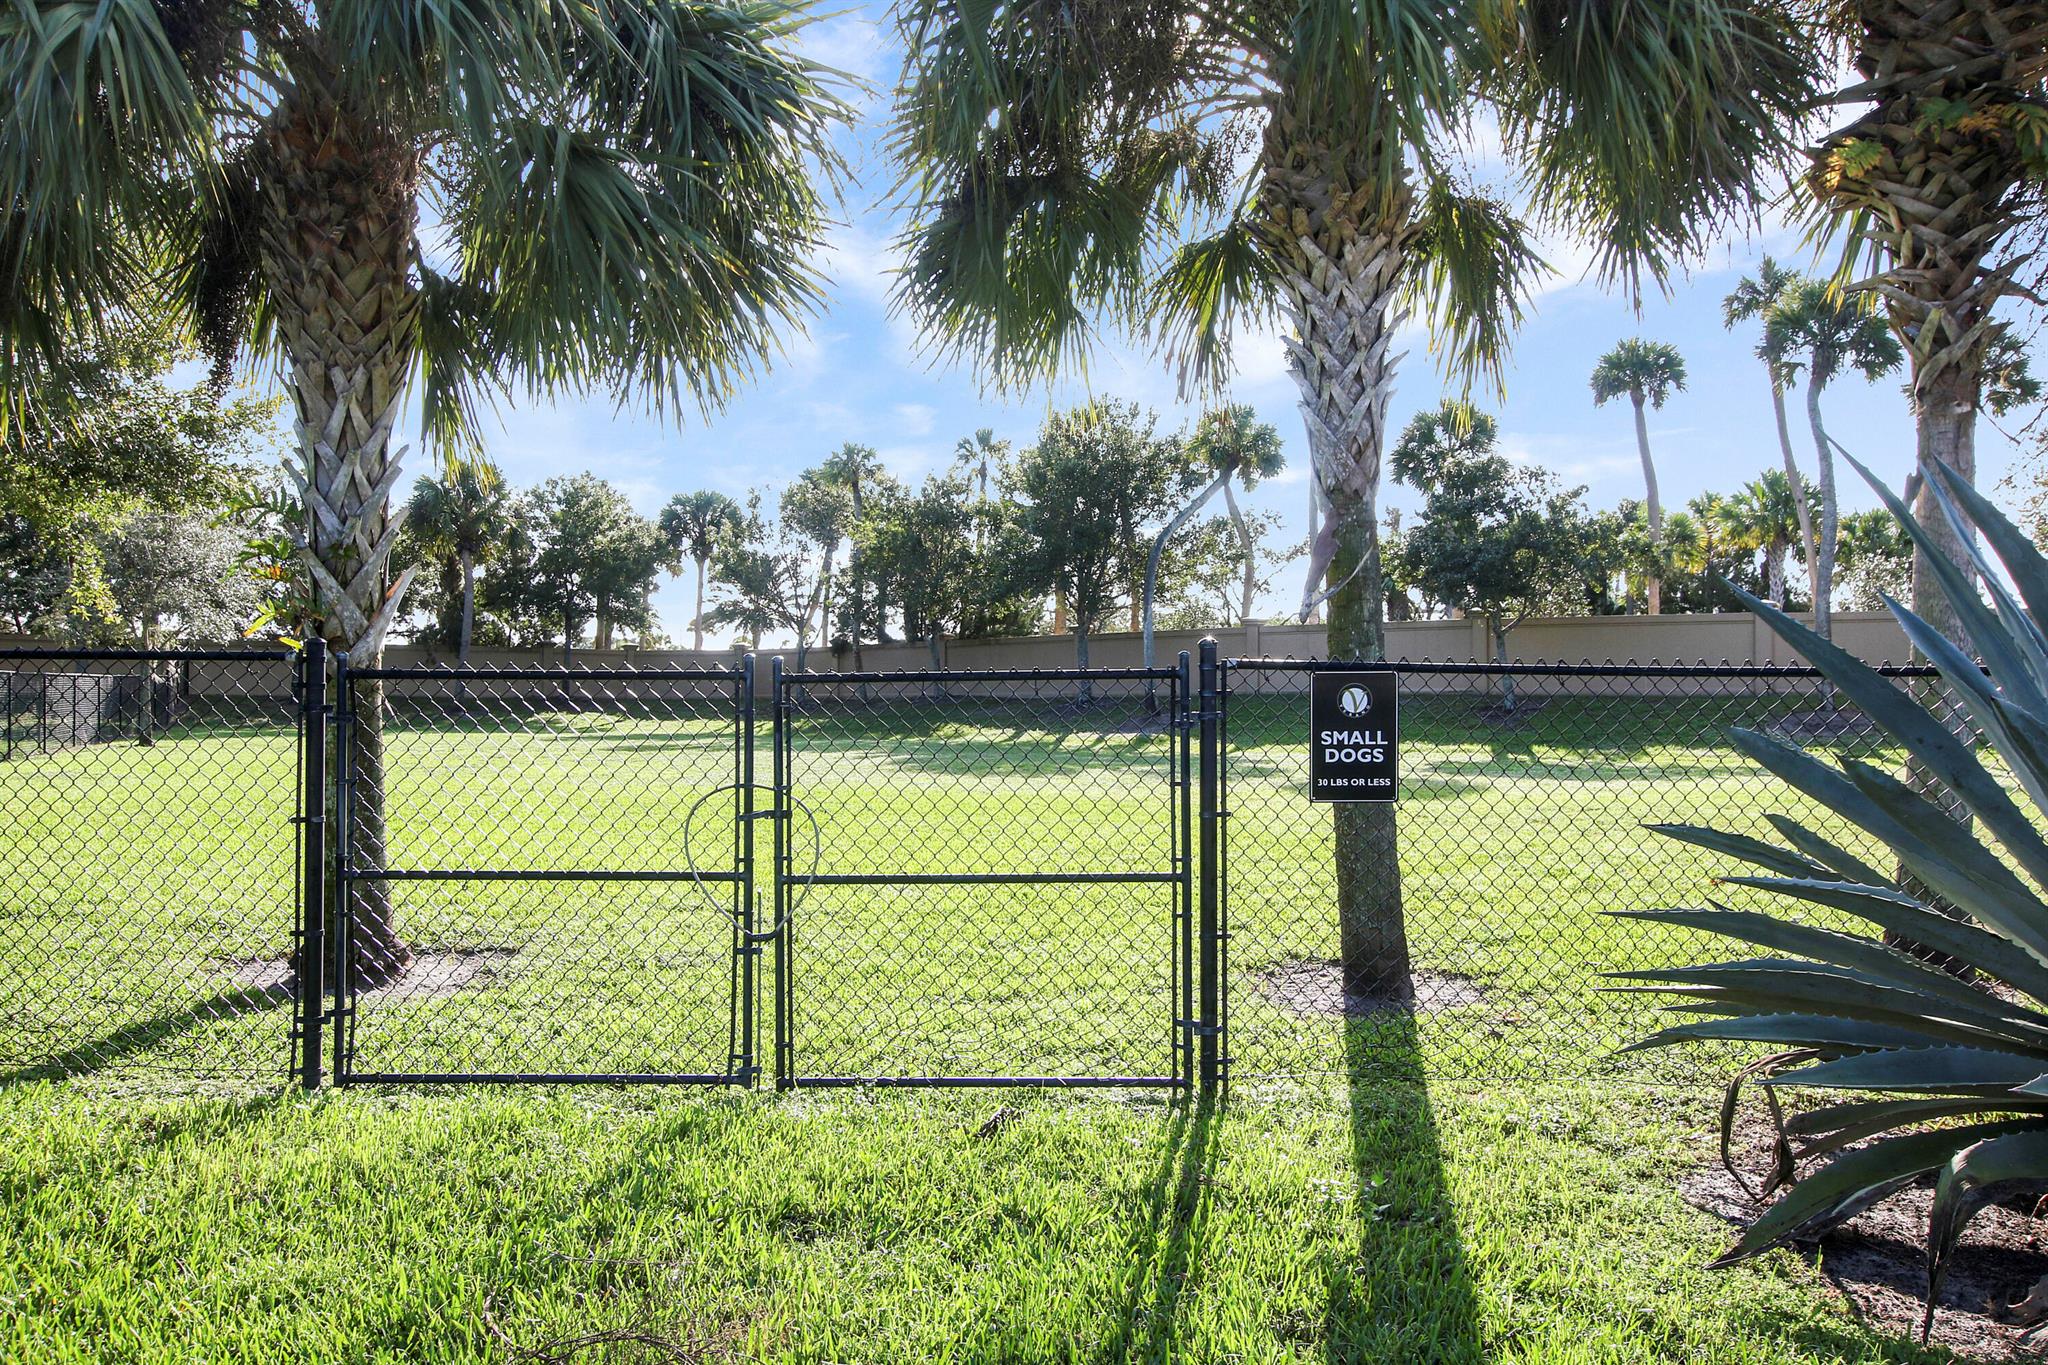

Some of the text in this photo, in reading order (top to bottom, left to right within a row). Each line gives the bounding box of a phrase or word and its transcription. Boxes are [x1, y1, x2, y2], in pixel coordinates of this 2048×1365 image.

[1320, 730, 1388, 745] SMALL
[1325, 748, 1384, 763] DOGS
[1317, 778, 1391, 787] 30 LBS OR LESS
